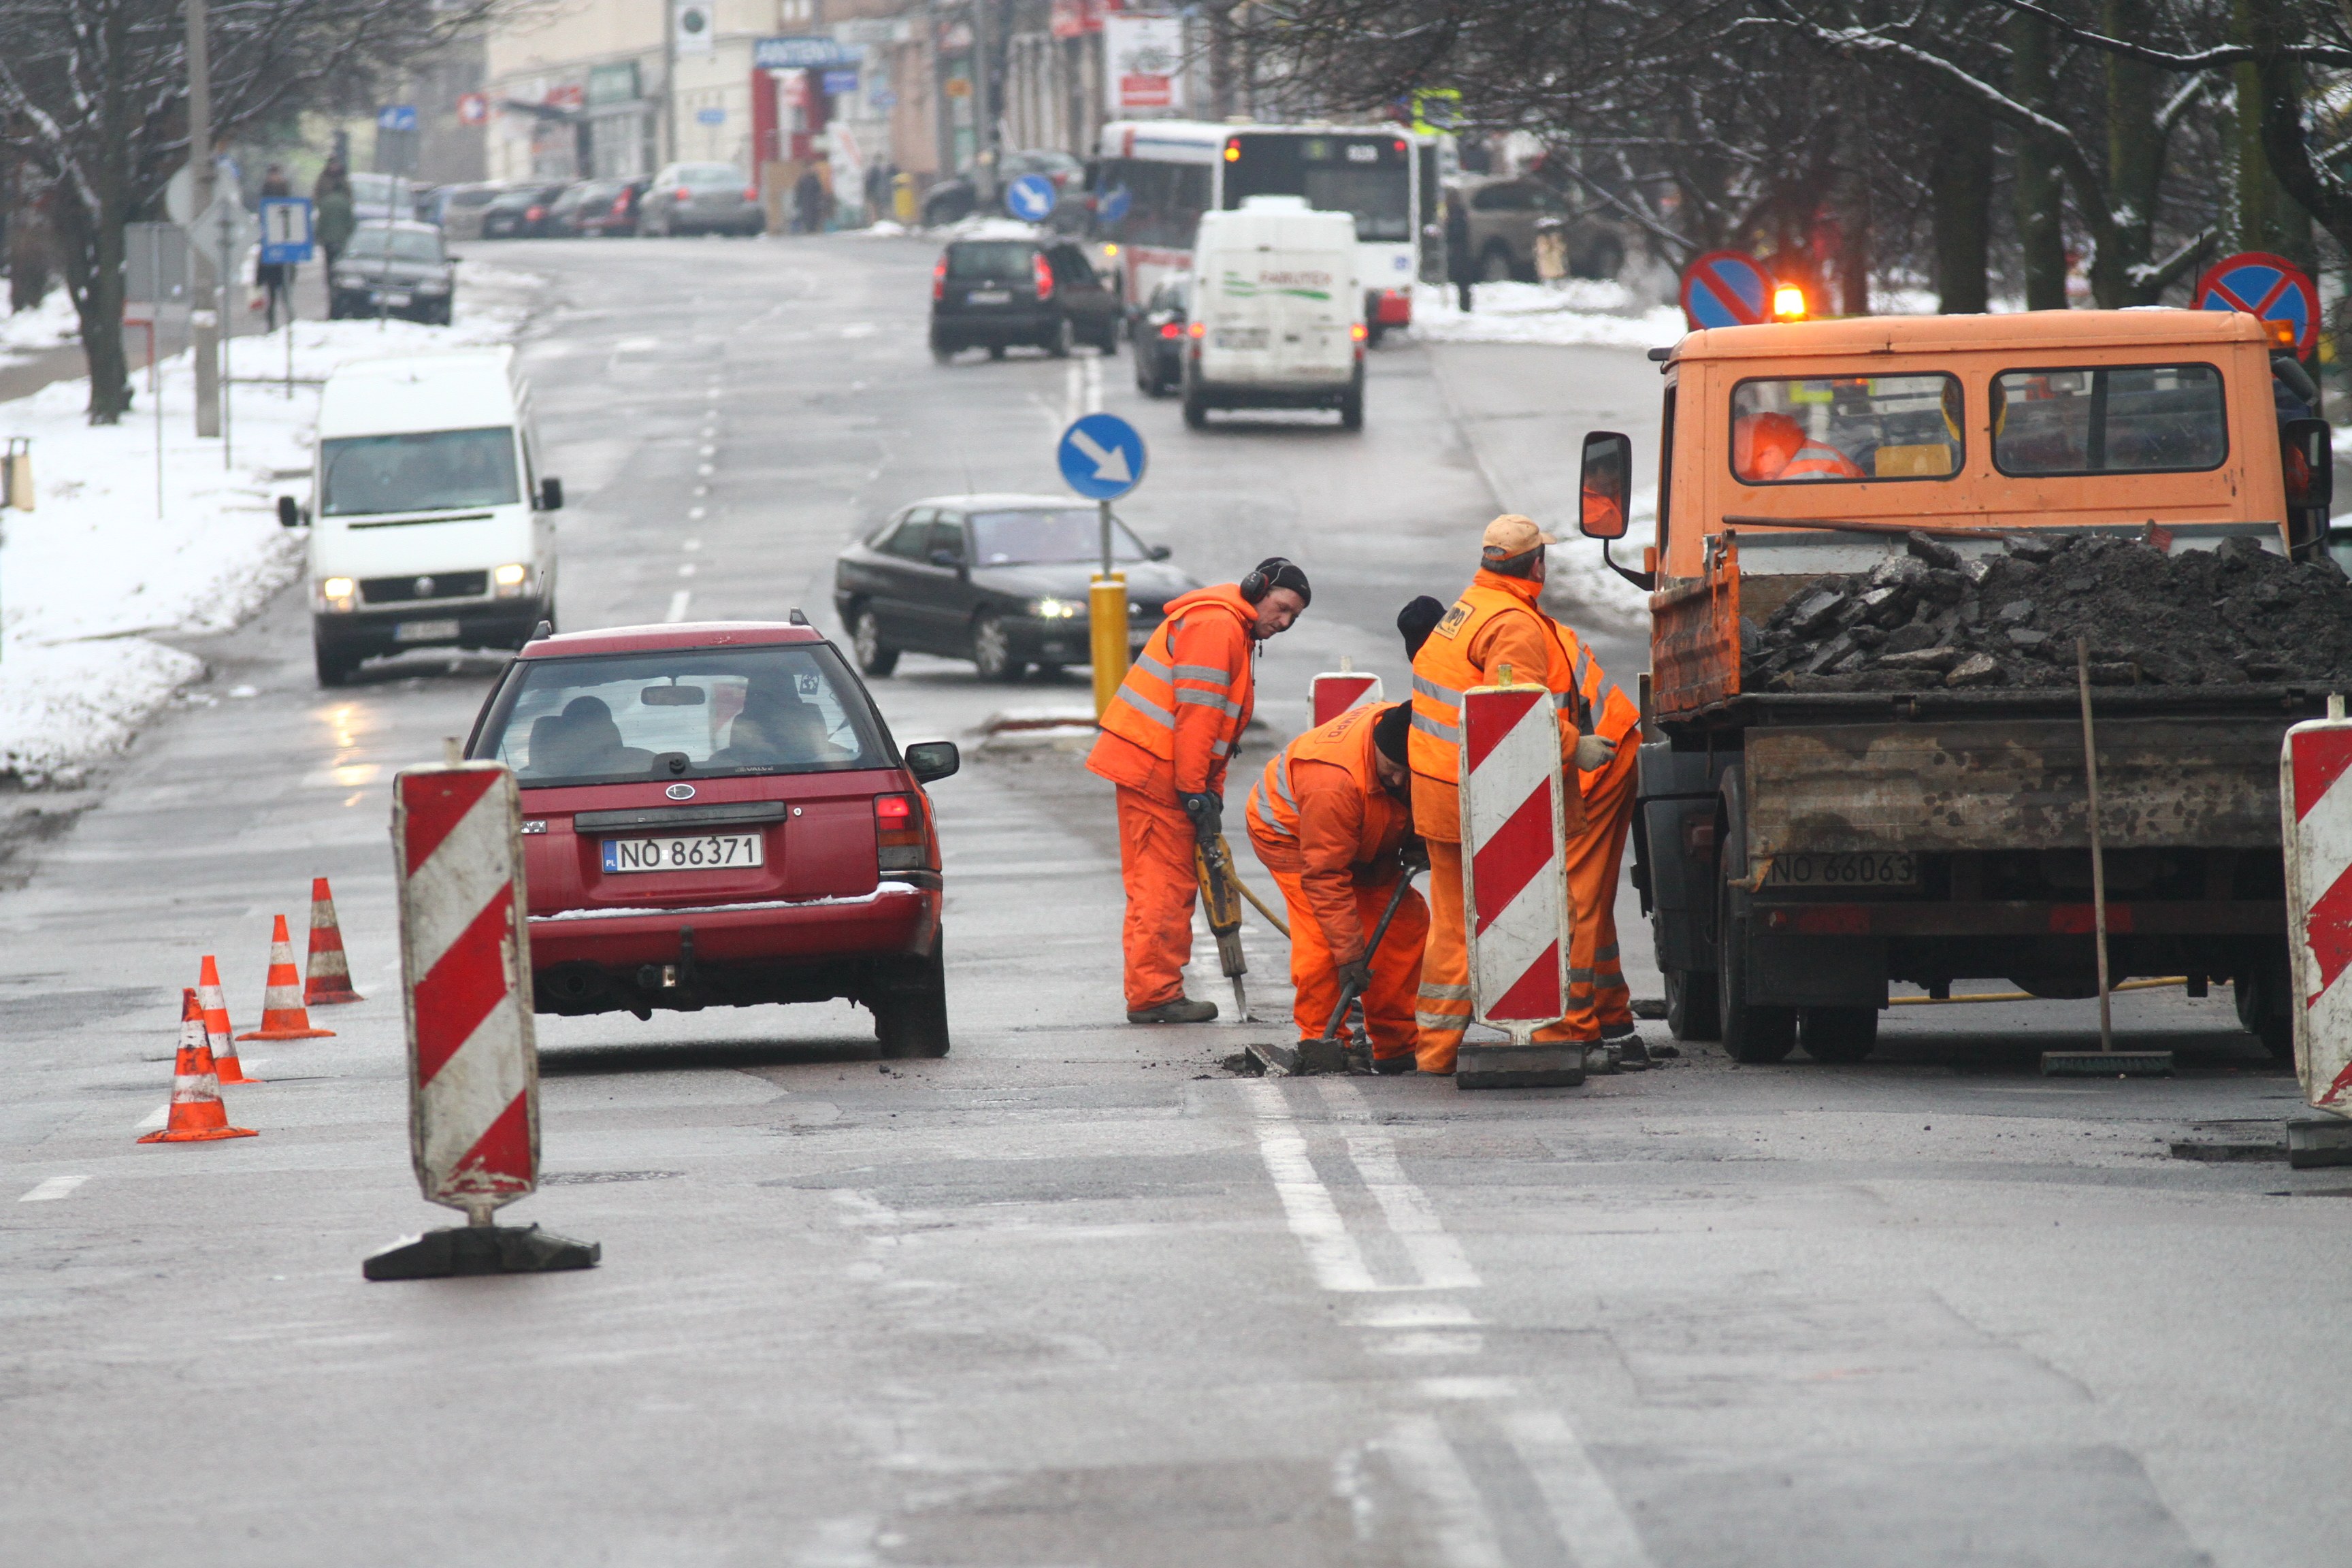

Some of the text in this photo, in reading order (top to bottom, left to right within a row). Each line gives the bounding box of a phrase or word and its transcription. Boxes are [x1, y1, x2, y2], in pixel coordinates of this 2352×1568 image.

[606, 859, 616, 868] PL
[621, 838, 753, 868] NO 86371
[1771, 855, 1914, 883] NO 66063
